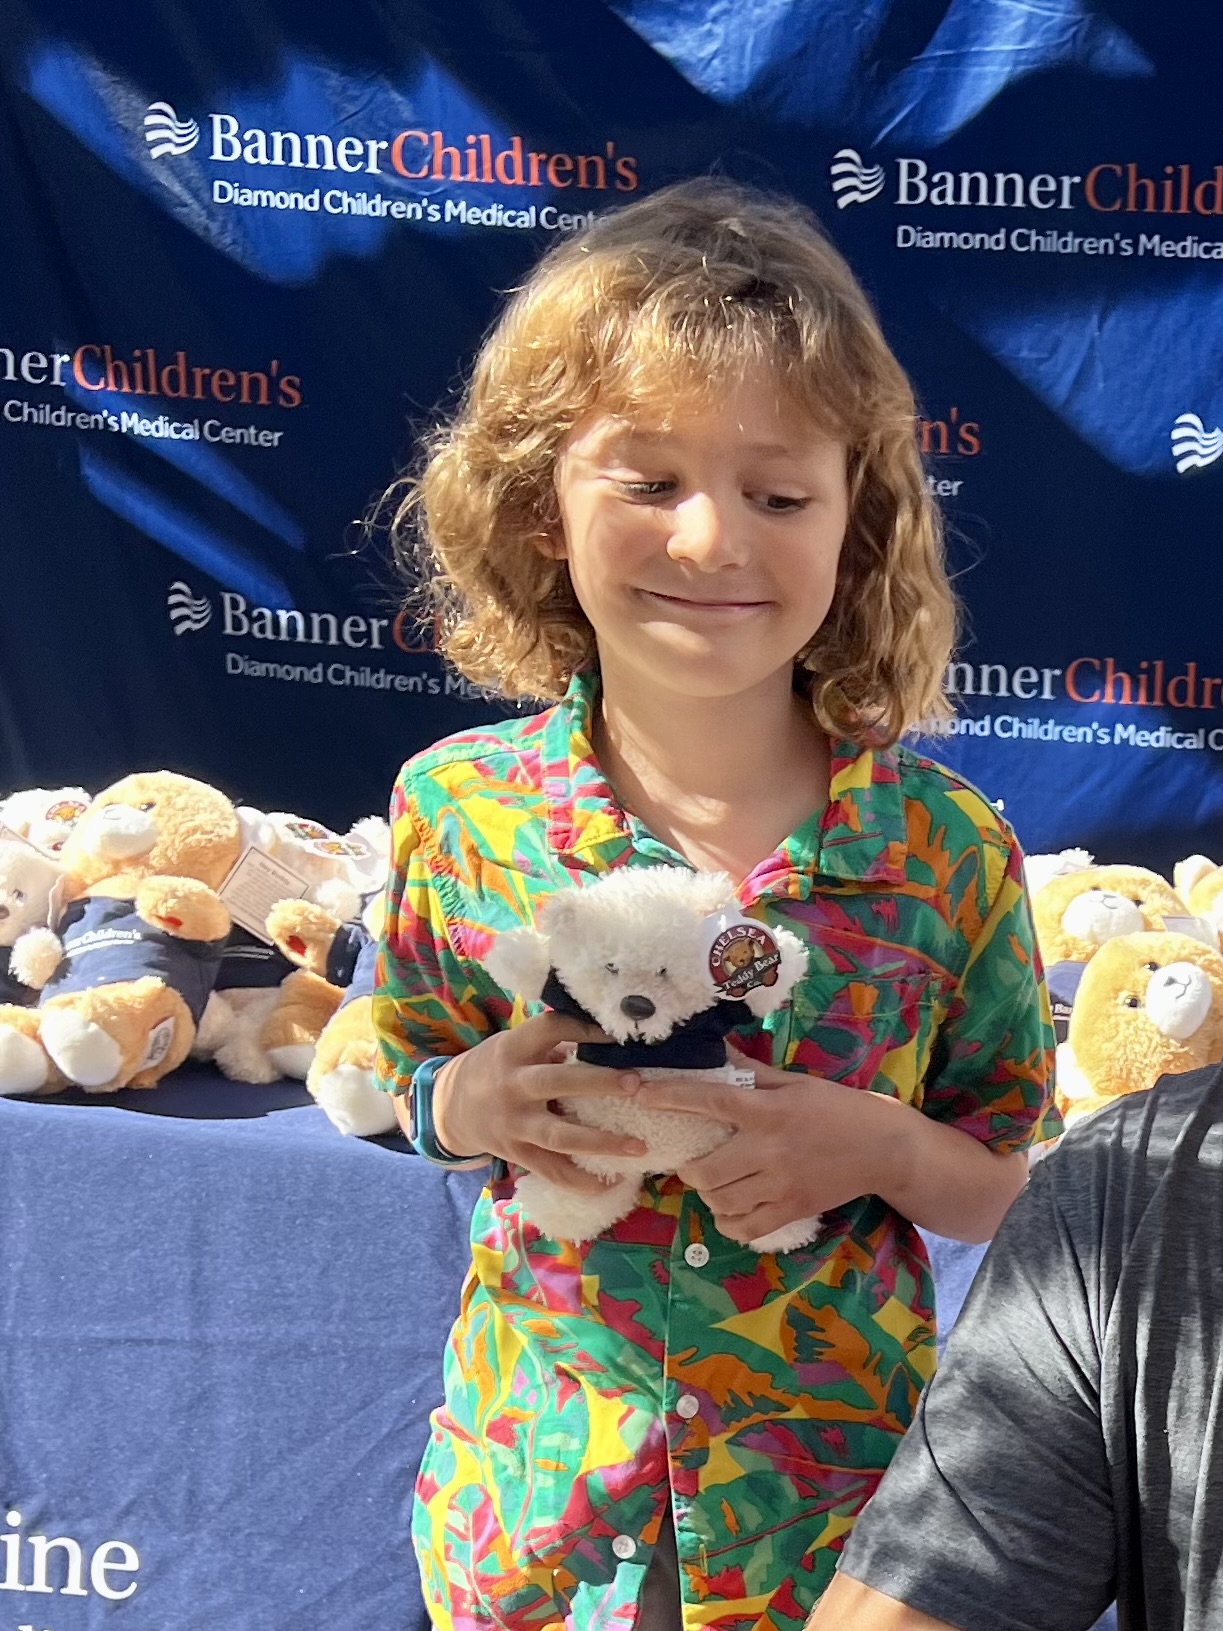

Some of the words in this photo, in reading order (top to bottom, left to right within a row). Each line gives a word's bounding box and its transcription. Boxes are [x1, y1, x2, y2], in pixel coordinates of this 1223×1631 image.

[212, 180, 320, 213] Diamond
[324, 190, 441, 222] Children's
[444, 199, 537, 230] Medical
[540, 206, 606, 232] Cent
[896, 225, 1004, 252] Diamond
[1010, 228, 1133, 257] Children's
[3, 400, 119, 433] Children's
[121, 410, 200, 441] Medical
[203, 419, 284, 448] Center
[226, 652, 323, 685] Diamond
[326, 662, 441, 696] Children's
[994, 714, 1111, 746] Children's
[1113, 722, 1205, 750] Medical
[711, 926, 767, 967] CHELSEA
[723, 968, 754, 990] Teddy
[753, 953, 779, 972] Bear
[0, 1510, 140, 1600] ine
